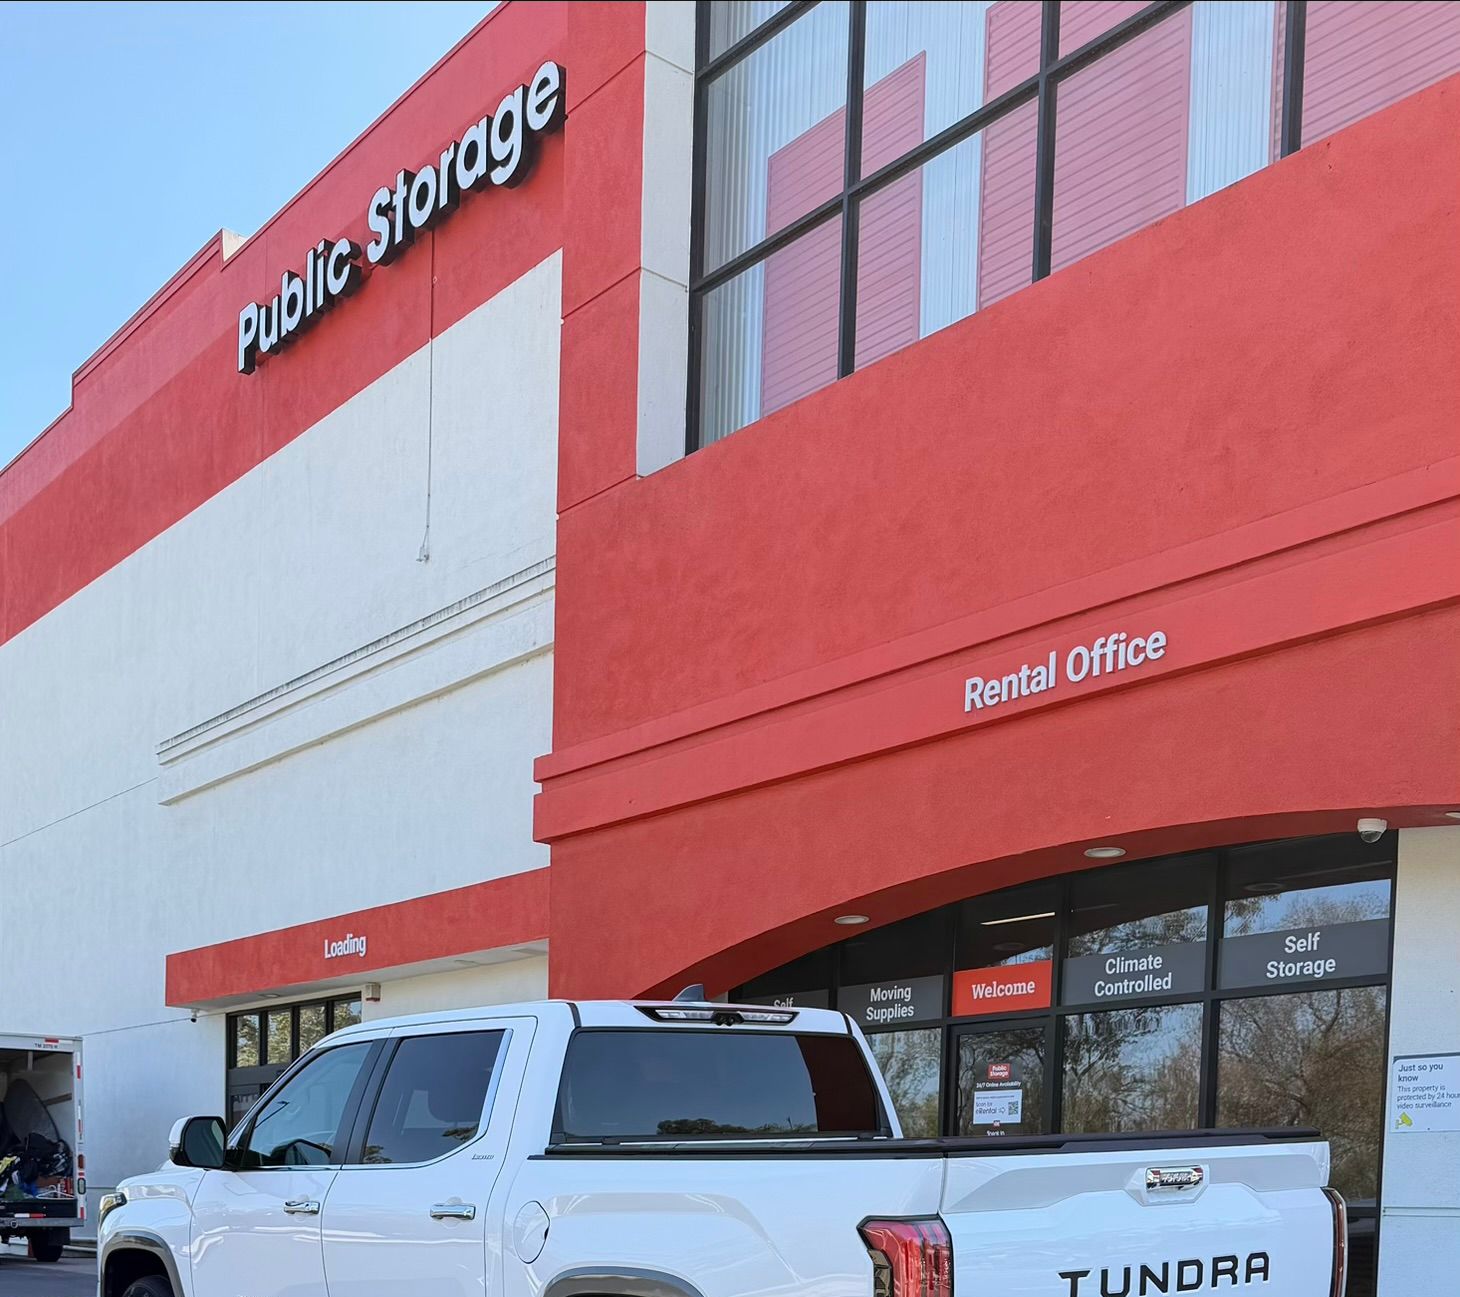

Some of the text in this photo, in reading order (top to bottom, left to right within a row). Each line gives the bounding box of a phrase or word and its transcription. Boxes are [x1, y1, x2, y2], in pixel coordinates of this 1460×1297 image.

[238, 60, 566, 374] Public Storage
[964, 630, 1167, 713] Rental Office
[324, 933, 367, 959] Loading
[1284, 932, 1321, 954] Self
[1105, 954, 1163, 976] Climate
[1266, 957, 1337, 979] Storage
[870, 986, 912, 1004] Moving
[971, 979, 1036, 1001] Welcome
[1094, 972, 1172, 998] Controlled
[866, 1003, 915, 1023] Supplies
[1398, 1064, 1416, 1072] Just
[1429, 1064, 1443, 1072] you
[1398, 1074, 1419, 1082] know
